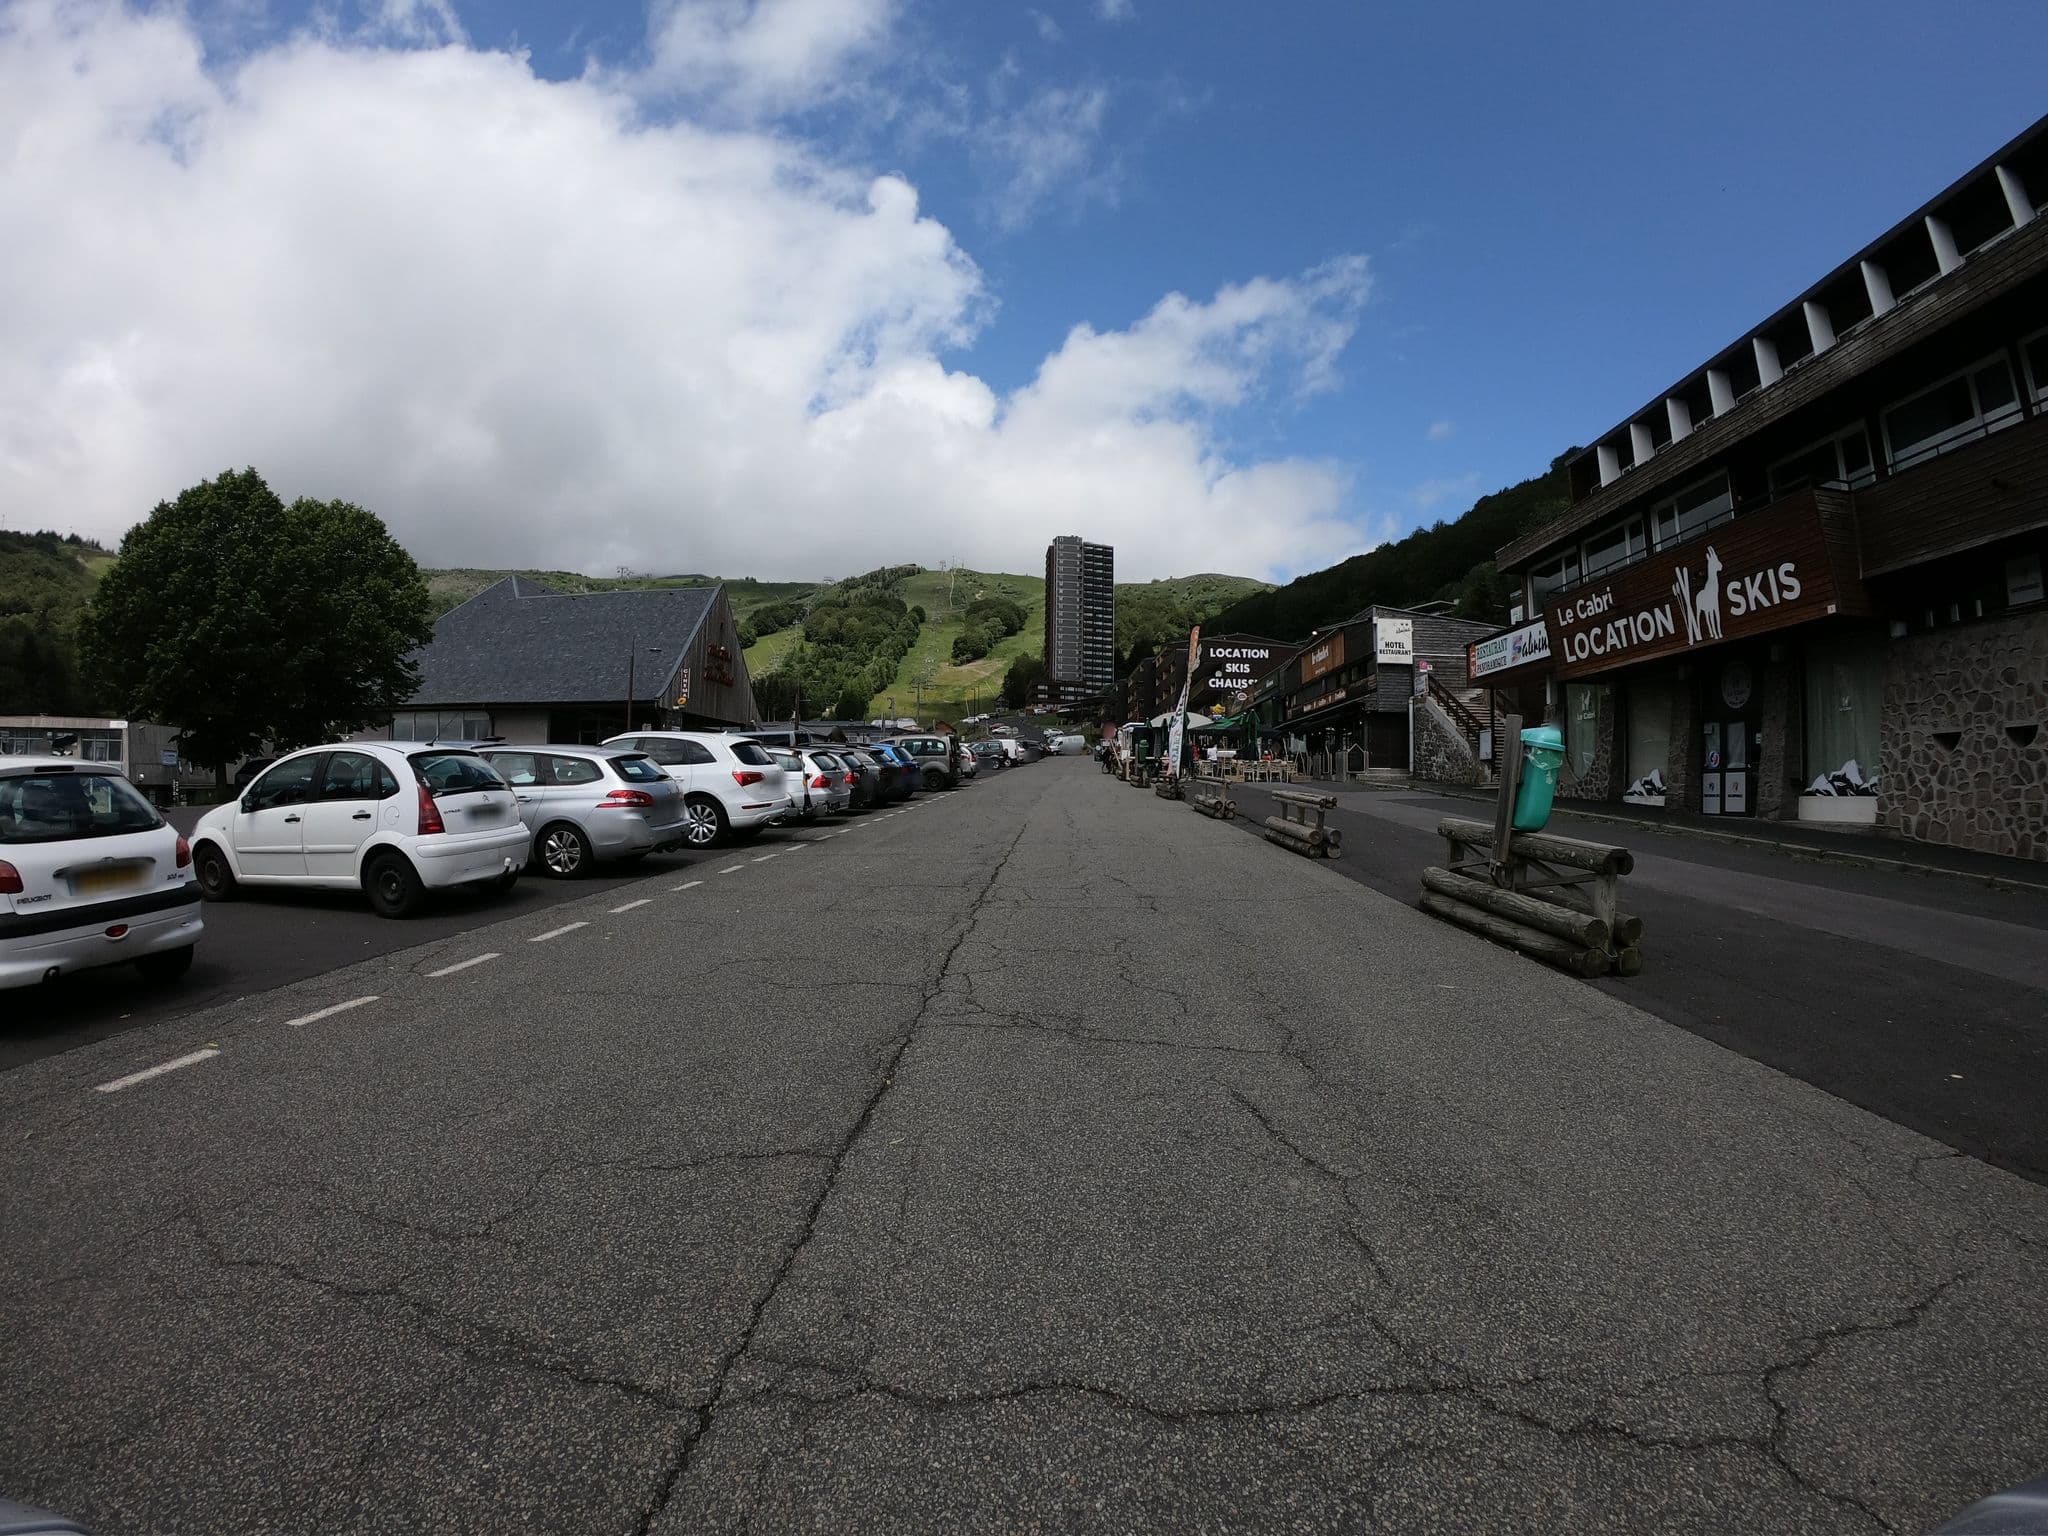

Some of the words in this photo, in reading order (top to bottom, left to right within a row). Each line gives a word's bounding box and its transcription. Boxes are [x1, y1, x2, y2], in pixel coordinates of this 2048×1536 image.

[1727, 562, 1801, 616] SKIS
[1557, 608, 1574, 627] Le
[1576, 586, 1613, 619] Cabri
[1563, 603, 1675, 663] LOCATION
[1210, 647, 1269, 659] LOCATION
[1385, 641, 1405, 649] HOTEL
[1477, 638, 1508, 659] RESTAURANT
[1225, 663, 1250, 673] SKIS
[17, 894, 52, 904] PEUGEOT
